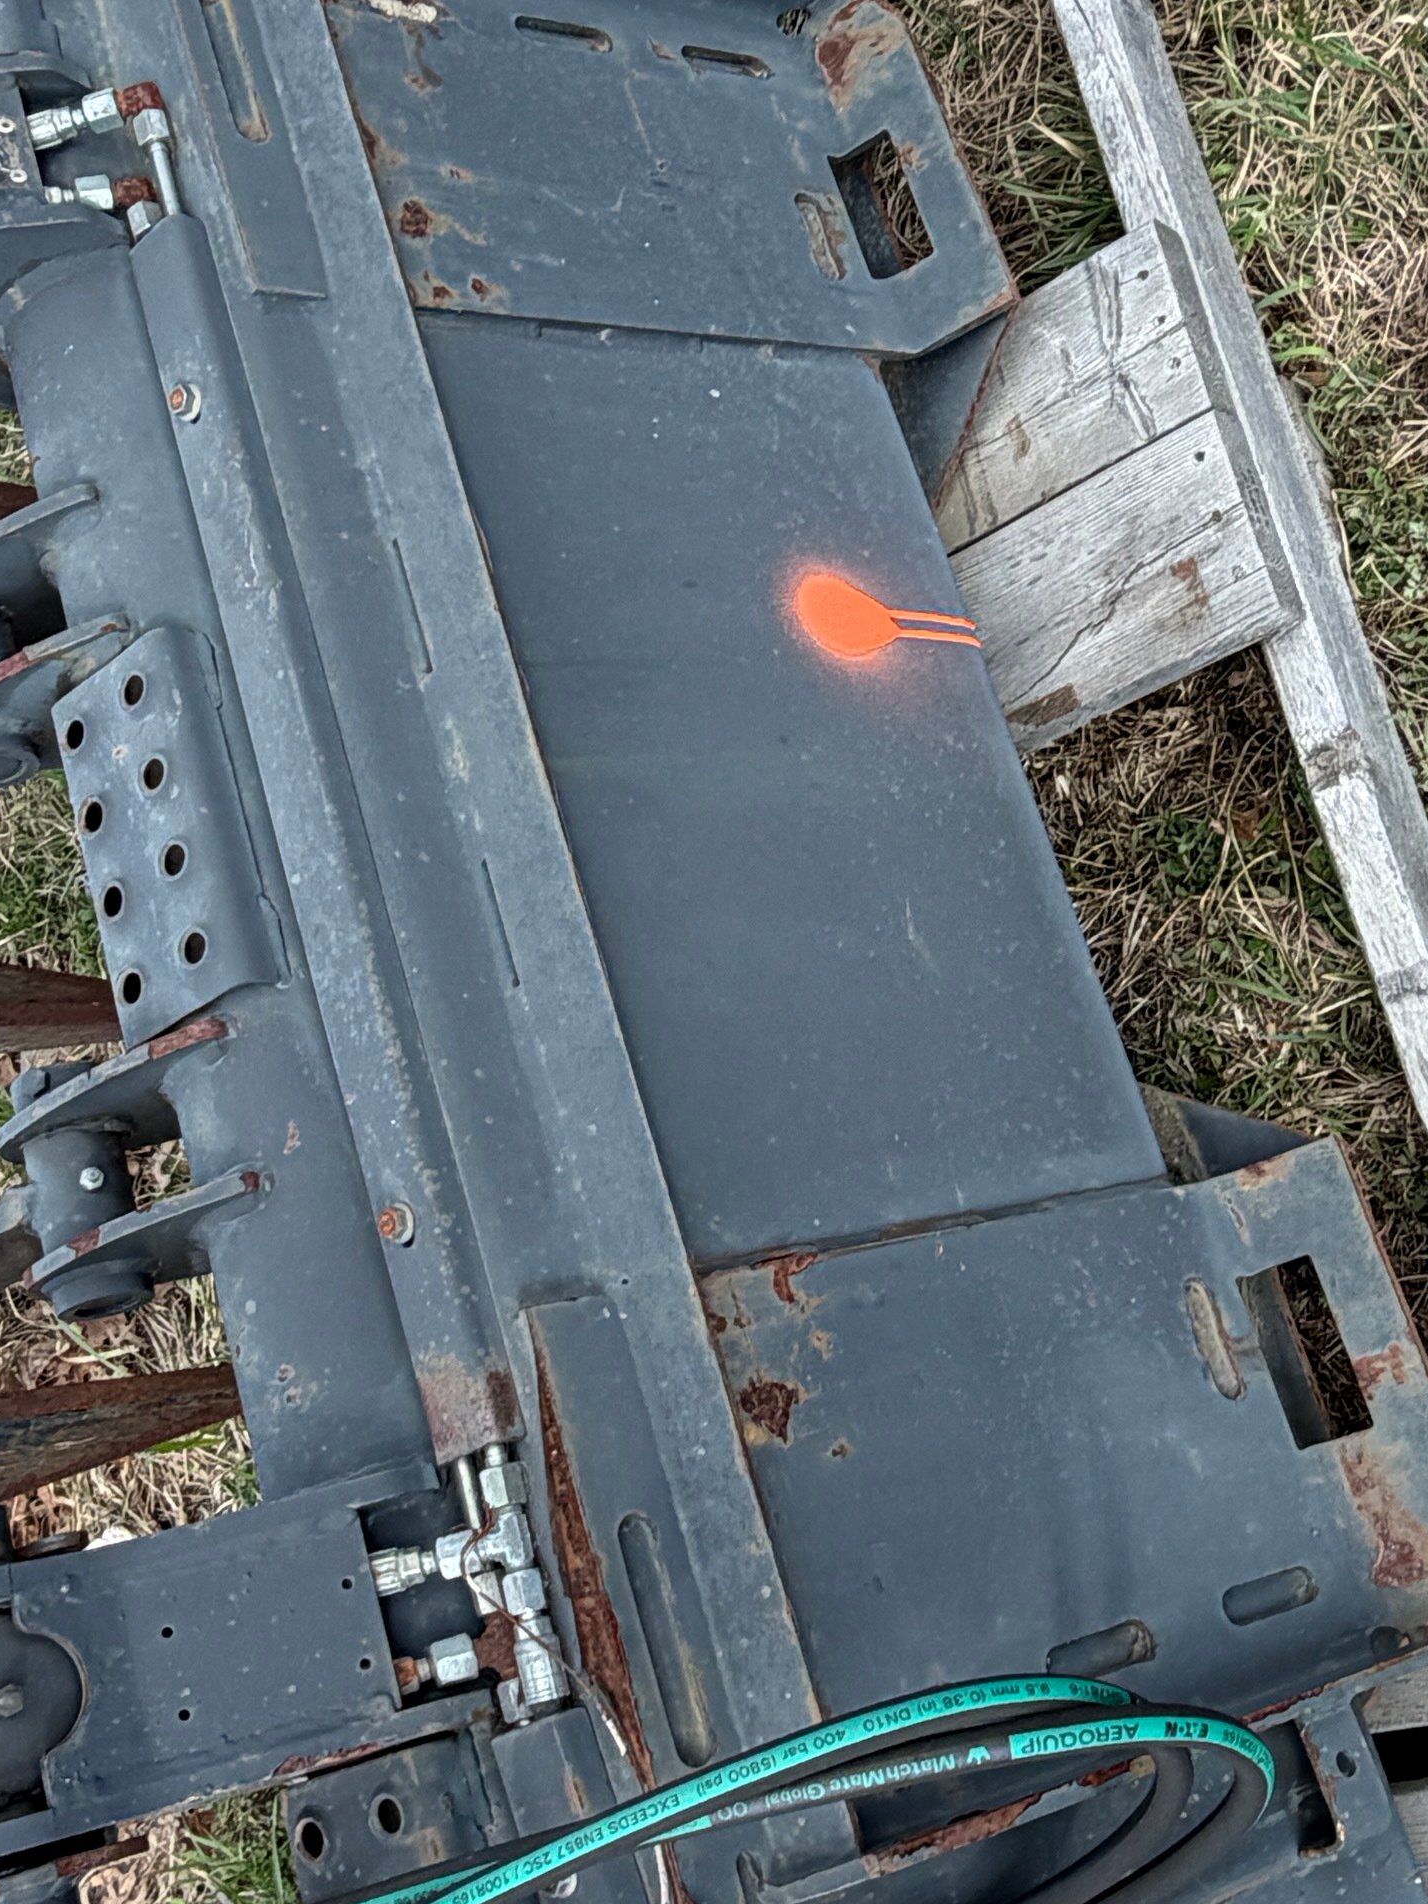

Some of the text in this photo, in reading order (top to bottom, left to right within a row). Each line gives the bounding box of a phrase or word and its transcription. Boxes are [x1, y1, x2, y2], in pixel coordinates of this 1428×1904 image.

[942, 1689, 987, 1709] (0.38
[990, 1685, 1020, 1696] mm
[1024, 1682, 1051, 1696] 9.5
[917, 1699, 938, 1717] in)
[862, 1709, 912, 1733] DN10
[813, 1728, 847, 1751] 400
[1022, 1723, 1139, 1754] AEROQUIP
[782, 1742, 809, 1761] bar
[728, 1754, 777, 1784] (5800
[829, 1753, 957, 1792] MatchMate
[696, 1775, 723, 1798] psi)
[764, 1783, 825, 1809] Global
[608, 1793, 680, 1836] EXCEEDS
[556, 1827, 605, 1863] EN857
[522, 1851, 553, 1874] 2SC
